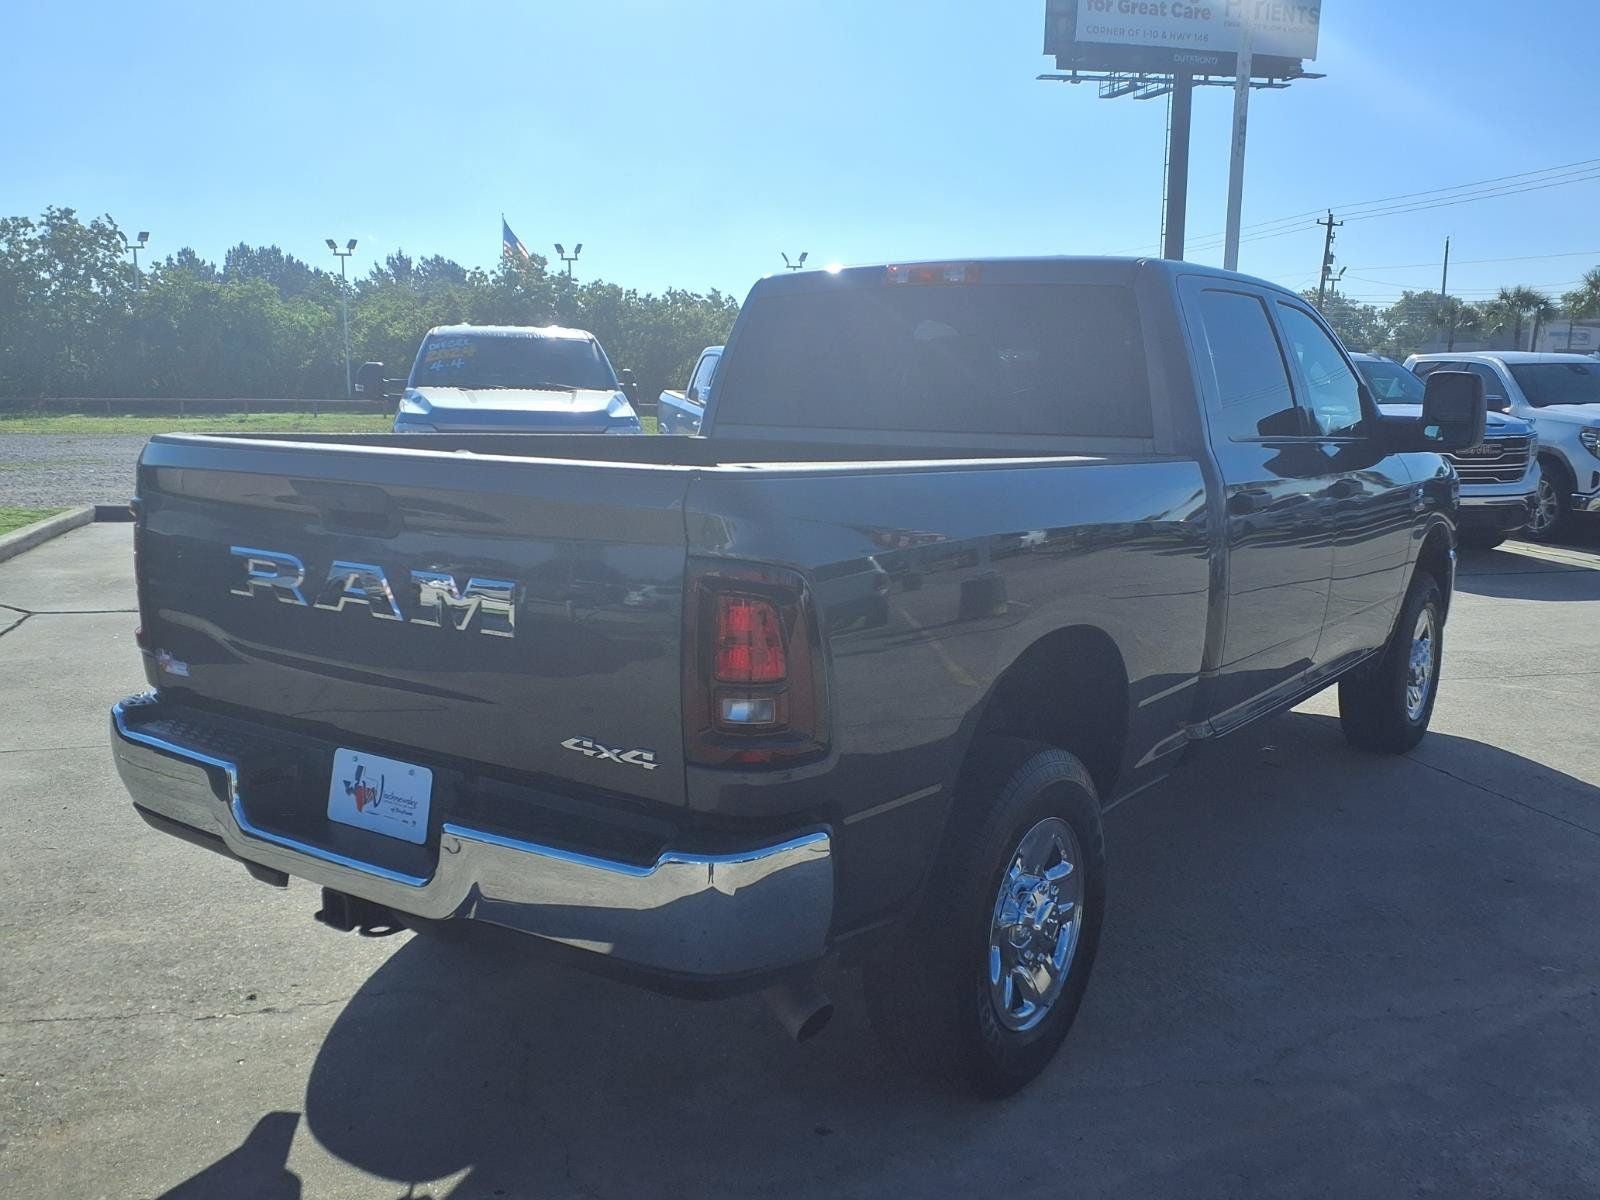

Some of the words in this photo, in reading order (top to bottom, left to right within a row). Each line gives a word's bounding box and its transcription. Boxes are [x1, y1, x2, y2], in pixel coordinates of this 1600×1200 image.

[1087, 0, 1113, 12] for
[1117, 0, 1167, 17] Great
[1171, 2, 1212, 20] Care
[1086, 25, 1125, 37] CORNER
[1127, 28, 1141, 38] OF
[1143, 30, 1159, 40] I-10
[1169, 31, 1192, 41] HWY
[230, 546, 520, 638] RAM
